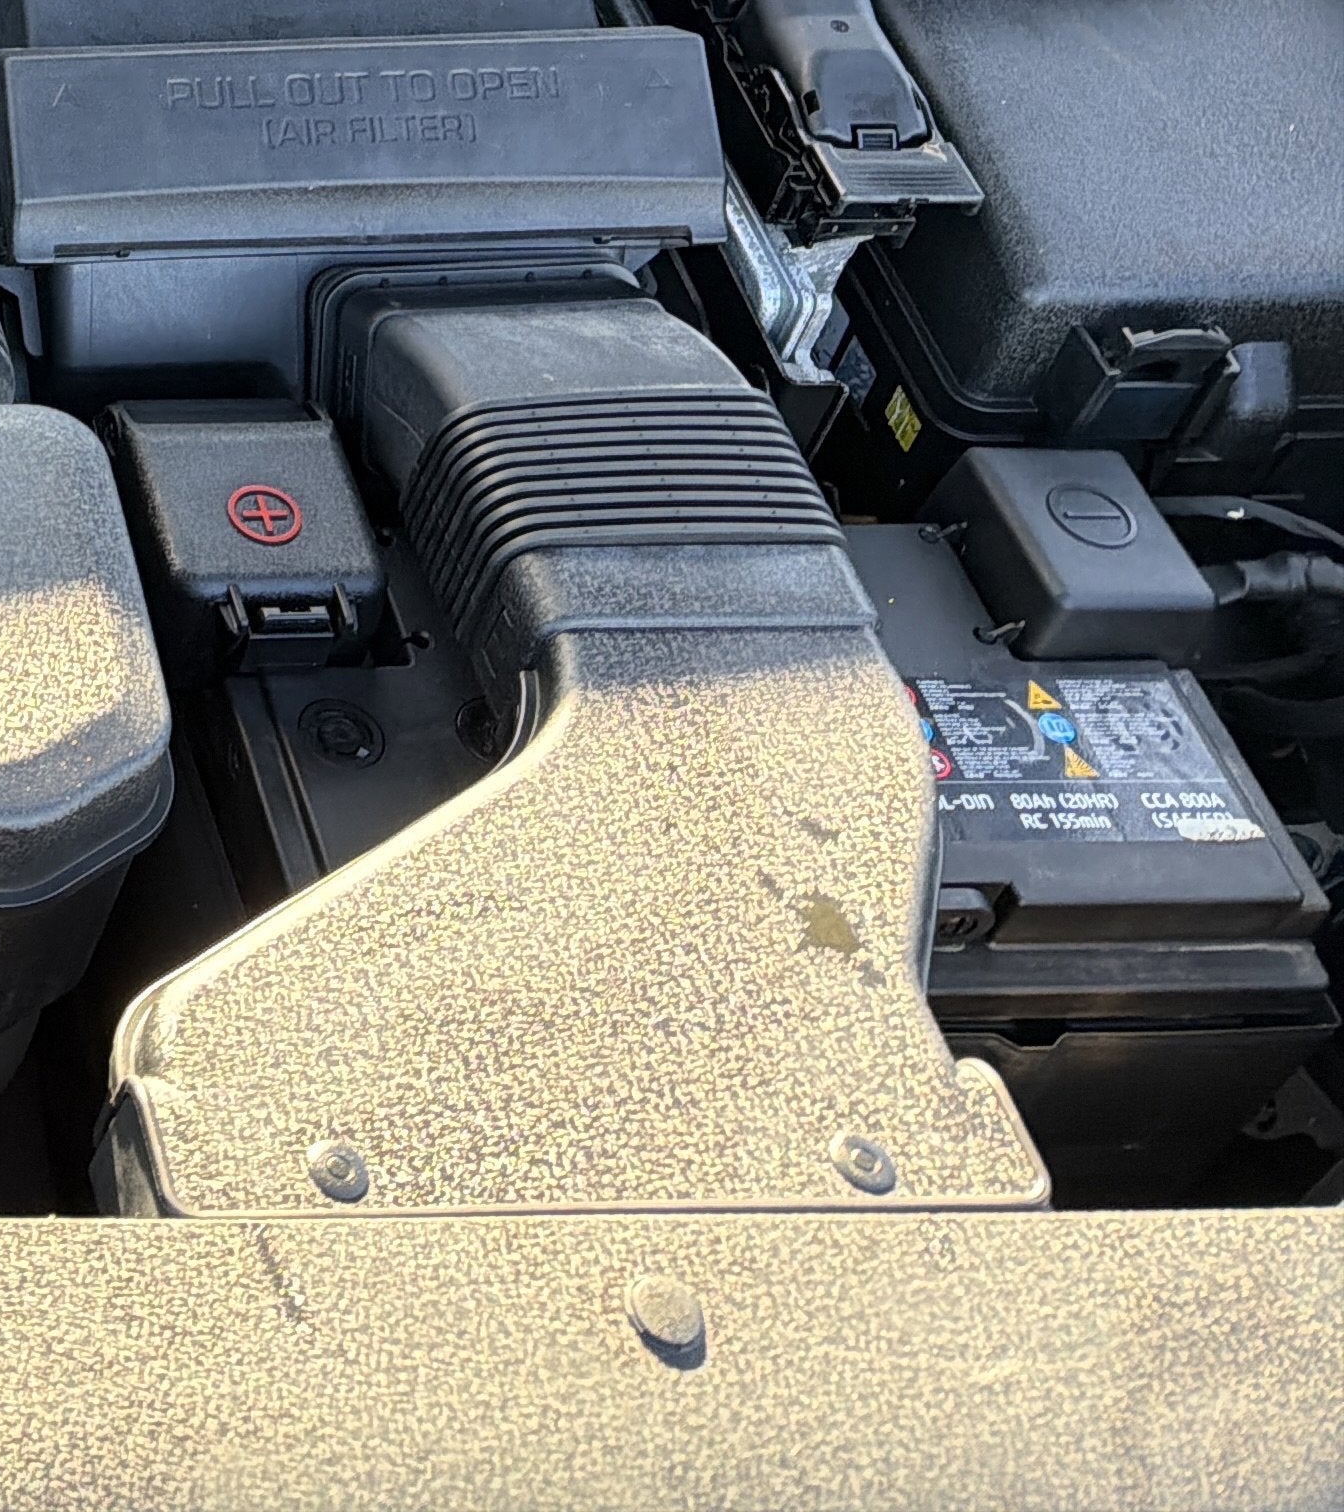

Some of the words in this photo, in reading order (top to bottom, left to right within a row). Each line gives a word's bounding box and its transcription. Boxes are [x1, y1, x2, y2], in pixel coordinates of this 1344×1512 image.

[164, 76, 276, 110] PULL
[283, 71, 369, 107] OUT
[379, 69, 437, 104] TO
[446, 66, 561, 102] OPEN
[262, 115, 337, 149] (AIR
[348, 112, 478, 144] FILTER)
[1009, 792, 1057, 810] 80Ah
[1058, 792, 1119, 811] (20HR)
[1140, 792, 1178, 809] CCA
[1178, 792, 1226, 809] 800A
[1019, 812, 1048, 830] RC
[1049, 812, 1112, 830] 155min
